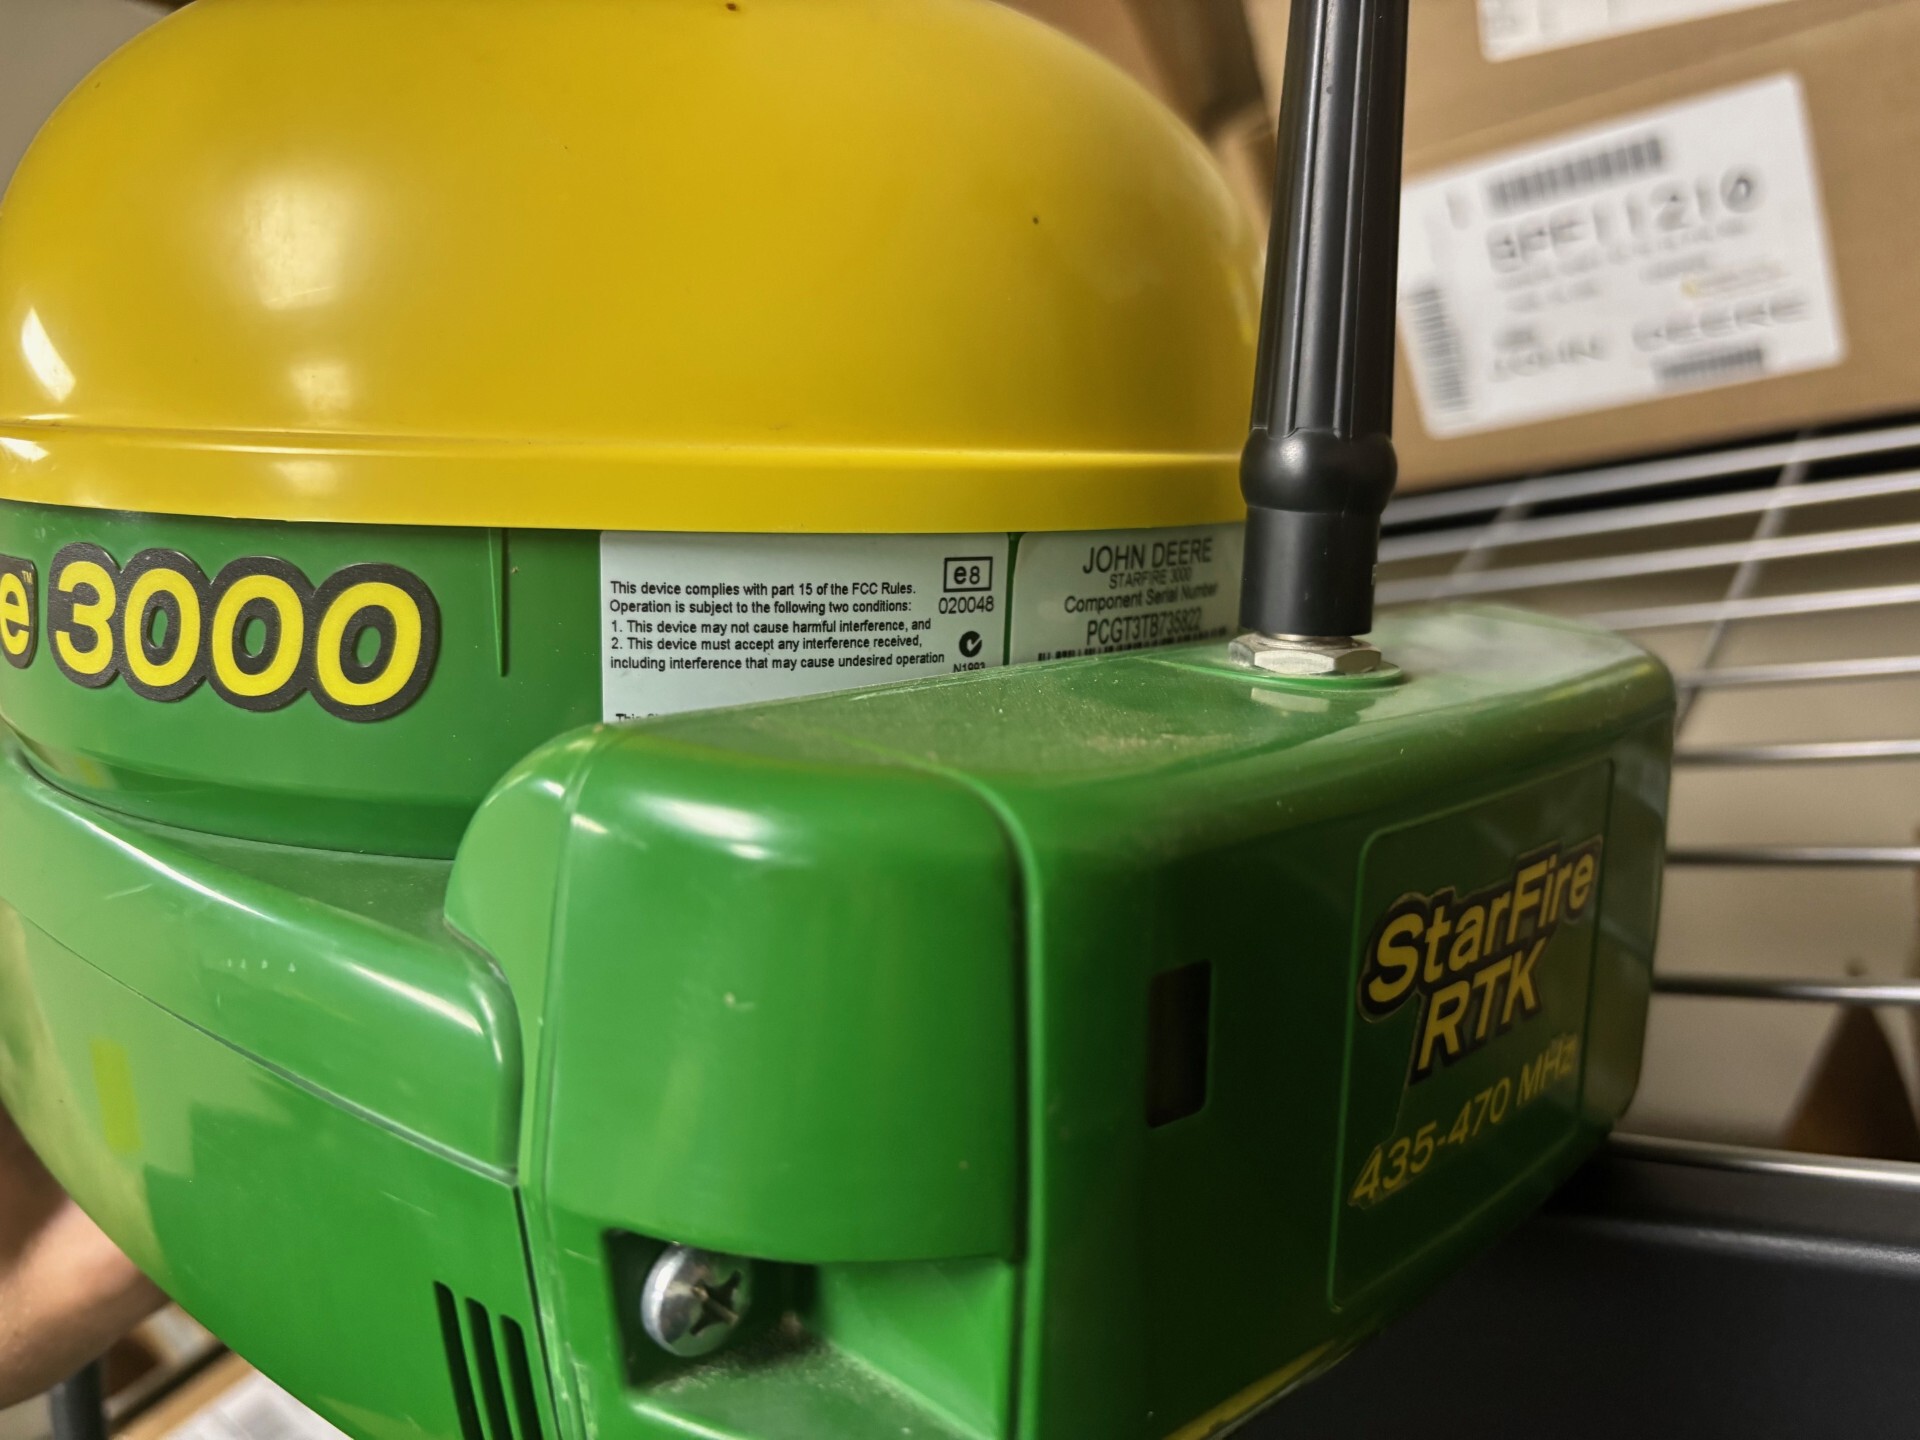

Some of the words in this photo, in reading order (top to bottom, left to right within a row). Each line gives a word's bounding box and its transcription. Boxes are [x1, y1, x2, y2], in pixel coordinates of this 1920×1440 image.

[1083, 545, 1146, 574] JOHN
[1153, 539, 1212, 567] DEERE
[953, 565, 981, 585] e8
[610, 580, 637, 594] This
[641, 581, 681, 595] device
[685, 582, 740, 598] complies
[743, 582, 768, 595] with
[771, 584, 795, 598] part
[799, 582, 813, 595] 15
[816, 583, 829, 595] of
[830, 583, 849, 595] the
[852, 582, 878, 595] FCC
[881, 581, 916, 595] Rules.
[1065, 592, 1142, 613] Component
[1146, 589, 1178, 606] Serial
[1181, 583, 1218, 600] Number
[609, 599, 671, 615] Operation
[675, 600, 685, 613] is
[689, 600, 733, 616] subject
[736, 601, 748, 613] to
[751, 601, 771, 613] the
[774, 600, 826, 616] following
[829, 601, 849, 613] two
[852, 599, 912, 612] conditions:
[938, 595, 994, 614] 020048
[56, 561, 421, 706] 3000
[611, 620, 623, 633] 1.
[626, 619, 653, 633] This
[657, 620, 697, 633] device
[701, 622, 728, 636] may
[731, 621, 750, 633] not
[753, 622, 789, 633] cause
[792, 620, 837, 633] harmful
[839, 619, 909, 633] interference,
[911, 618, 932, 630] and
[611, 636, 623, 650] 2.
[626, 636, 653, 650] This
[657, 637, 697, 650] device
[701, 638, 731, 650] must
[734, 638, 775, 653] accept
[778, 640, 800, 653] any
[802, 636, 870, 650] interference
[873, 634, 922, 648] received,
[610, 656, 666, 672] including
[669, 656, 742, 669] interference
[745, 656, 768, 669] that
[771, 658, 798, 672] may
[800, 658, 835, 668] cause
[838, 653, 893, 668] undesired
[895, 651, 945, 668] operation
[1368, 853, 1595, 1004] StarFire
[1417, 937, 1546, 1071] RTK
[1352, 1076, 1512, 1199] 435-470
[1516, 1032, 1579, 1107] MHz
